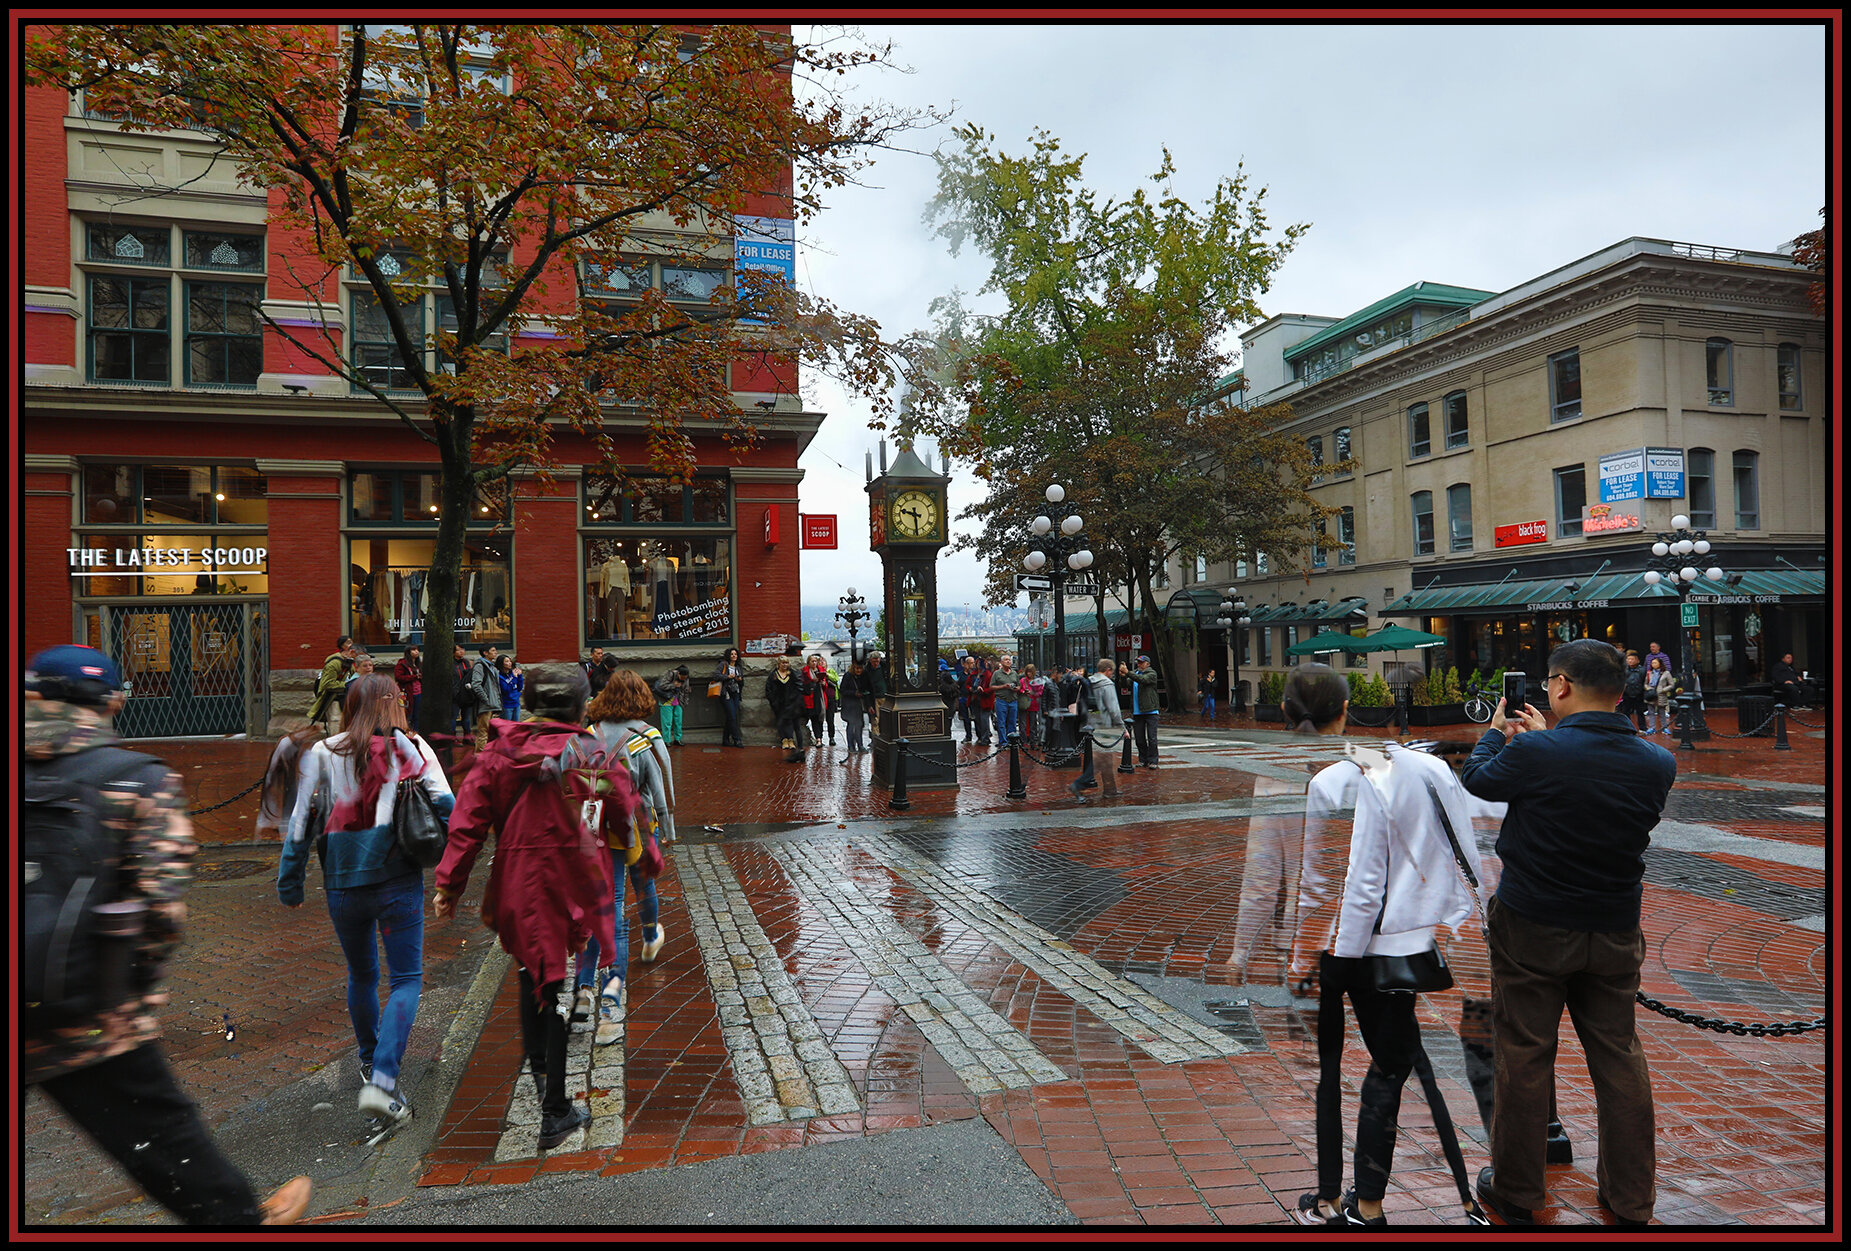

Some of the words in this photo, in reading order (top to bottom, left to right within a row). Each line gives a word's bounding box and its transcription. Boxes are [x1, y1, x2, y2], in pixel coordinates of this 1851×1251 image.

[738, 245, 759, 258] FOR
[761, 247, 792, 260] LEASE
[744, 262, 786, 272] Retail/Office
[1609, 459, 1640, 472] corbel
[1655, 458, 1680, 467] corbel
[1605, 477, 1618, 486] FOR
[1618, 473, 1638, 483] LEASE
[1652, 471, 1663, 480] FOR
[1663, 472, 1680, 480] LEASE
[1583, 513, 1638, 532] Michelle's
[1518, 523, 1534, 537] black
[1534, 522, 1546, 537] frog
[66, 548, 108, 567] THE
[115, 548, 194, 567] LATEST
[201, 547, 267, 567] SCOOP
[1068, 585, 1087, 594] WATER
[1527, 601, 1573, 611] STARBUCKS
[1577, 599, 1609, 608] COFFEE
[1755, 595, 1781, 603] COFFEE
[657, 596, 729, 623] Photobombing
[1685, 606, 1694, 614] NO
[410, 618, 425, 627] LAT
[454, 618, 476, 627] OOP
[654, 625, 671, 635] the
[673, 615, 703, 630] steam
[704, 606, 729, 620] clock
[1684, 615, 1696, 624] EXIT
[678, 626, 703, 639] since
[705, 617, 730, 631] 2018
[1116, 636, 1131, 648] black
